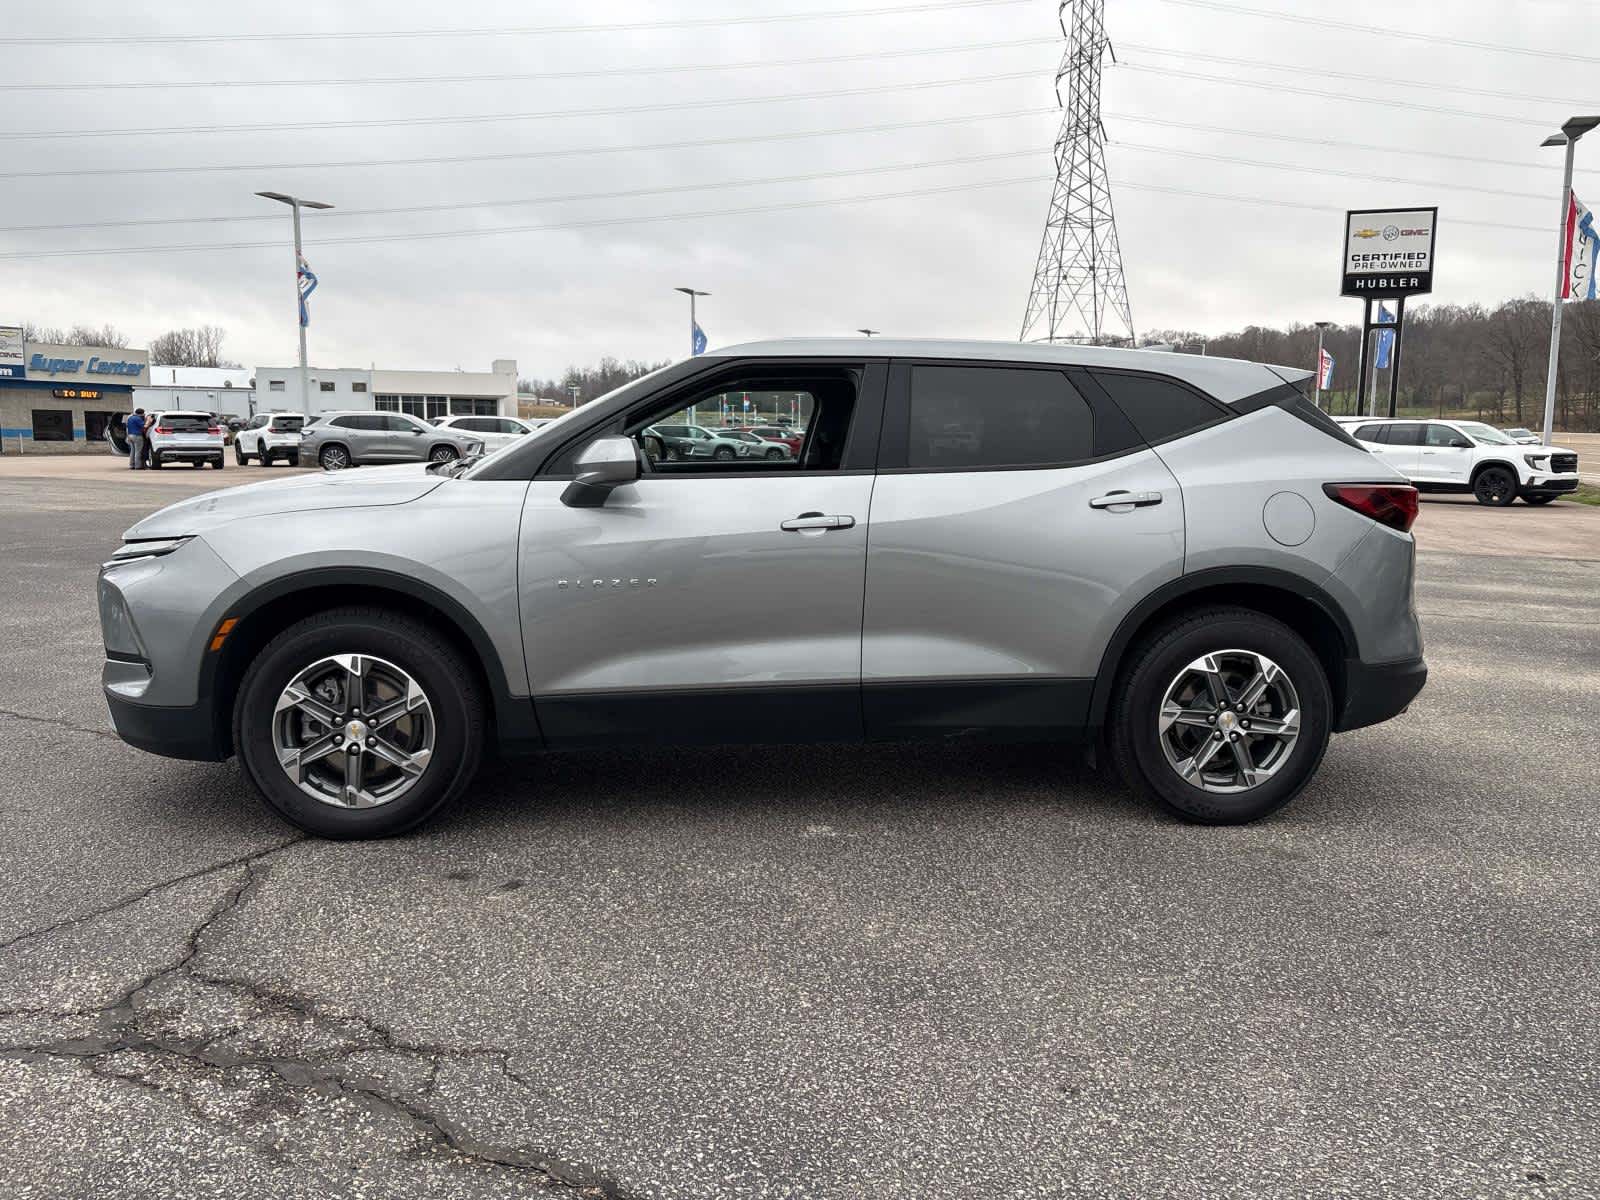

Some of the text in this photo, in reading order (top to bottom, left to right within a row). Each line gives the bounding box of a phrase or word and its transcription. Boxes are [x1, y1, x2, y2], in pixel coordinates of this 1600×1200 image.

[1351, 252, 1427, 262] CERTIFIED
[1354, 260, 1422, 270] PRE-OWNED
[1356, 277, 1419, 289] HUBLER
[29, 353, 146, 377] Super Center
[63, 390, 98, 398] TO BUY
[557, 578, 658, 588] BLAZER
